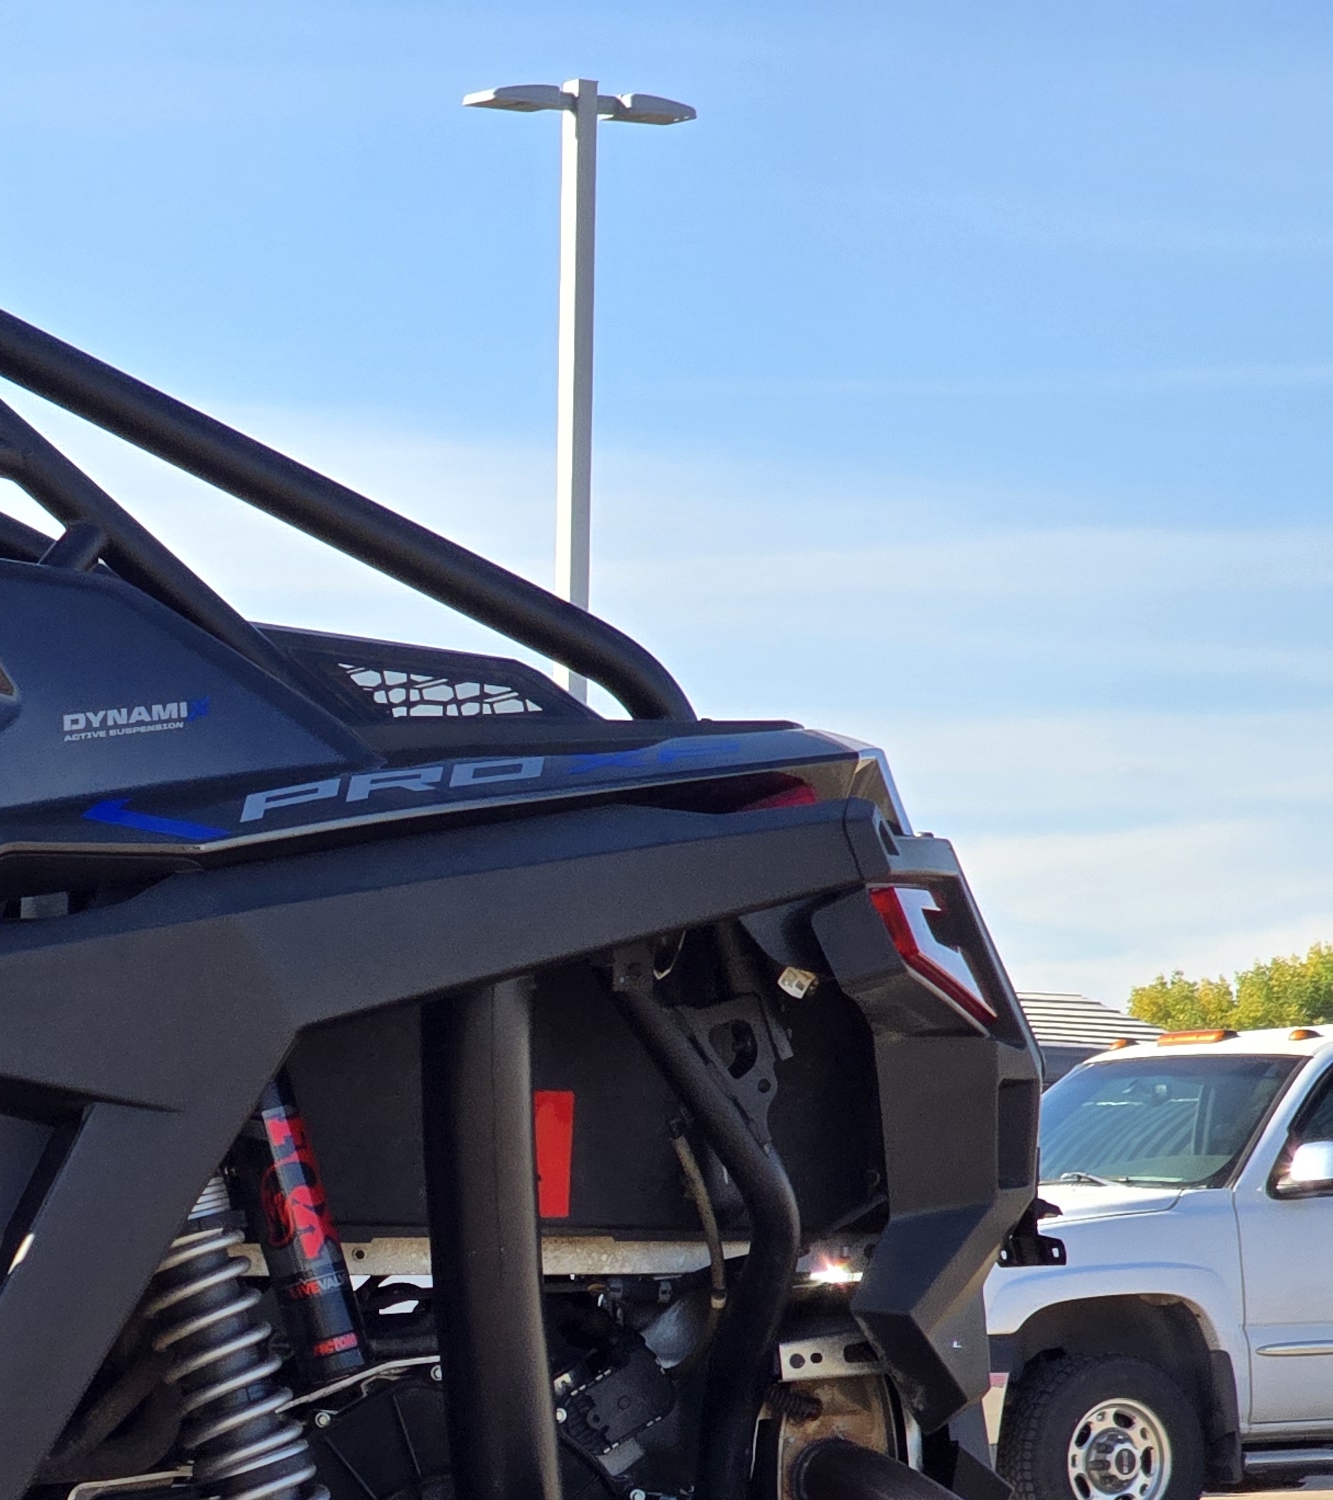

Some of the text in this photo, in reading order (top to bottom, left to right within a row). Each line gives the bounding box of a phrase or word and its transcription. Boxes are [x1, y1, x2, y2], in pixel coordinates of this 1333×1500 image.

[62, 695, 210, 732] DYNAMIX
[63, 721, 185, 742] ACTIVE SUSPENSION
[239, 756, 545, 823] PRO
